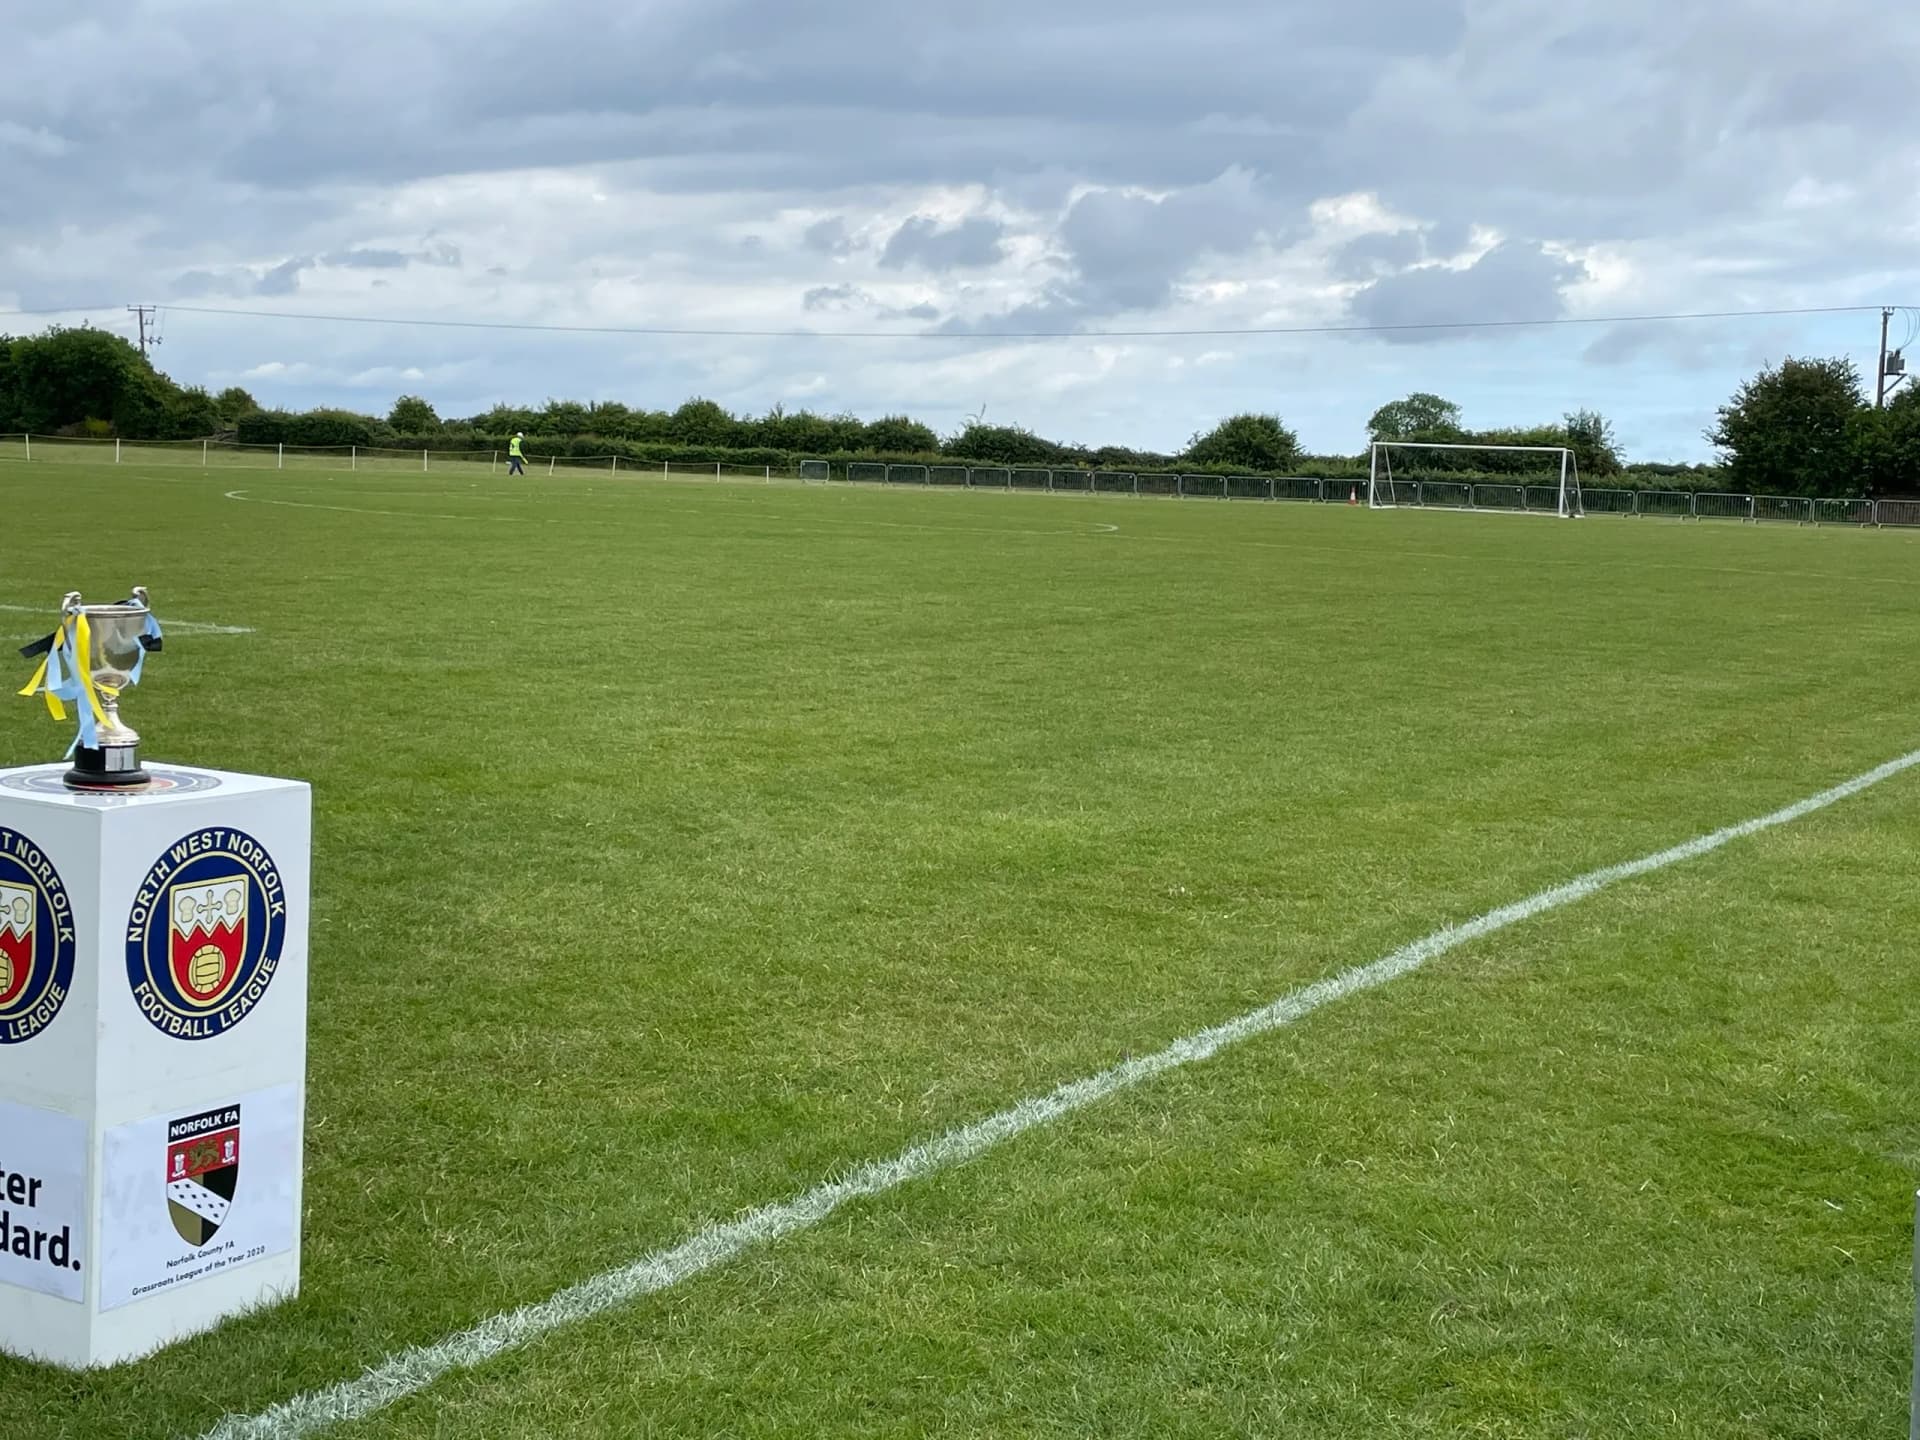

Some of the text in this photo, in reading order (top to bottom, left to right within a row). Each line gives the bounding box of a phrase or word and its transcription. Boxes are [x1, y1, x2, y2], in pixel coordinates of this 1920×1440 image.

[16, 839, 74, 943] NORFOLK
[128, 831, 284, 942] NORTH WEST NORFOLK
[9, 982, 65, 1039] LEAGUE
[134, 957, 276, 1037] FOOTBALL LEAGUE
[171, 1110, 238, 1137] NORFOLK FA
[132, 1245, 265, 1296] Grassroots League of the Year 2020
[166, 1240, 235, 1269] Norfolk County FA
